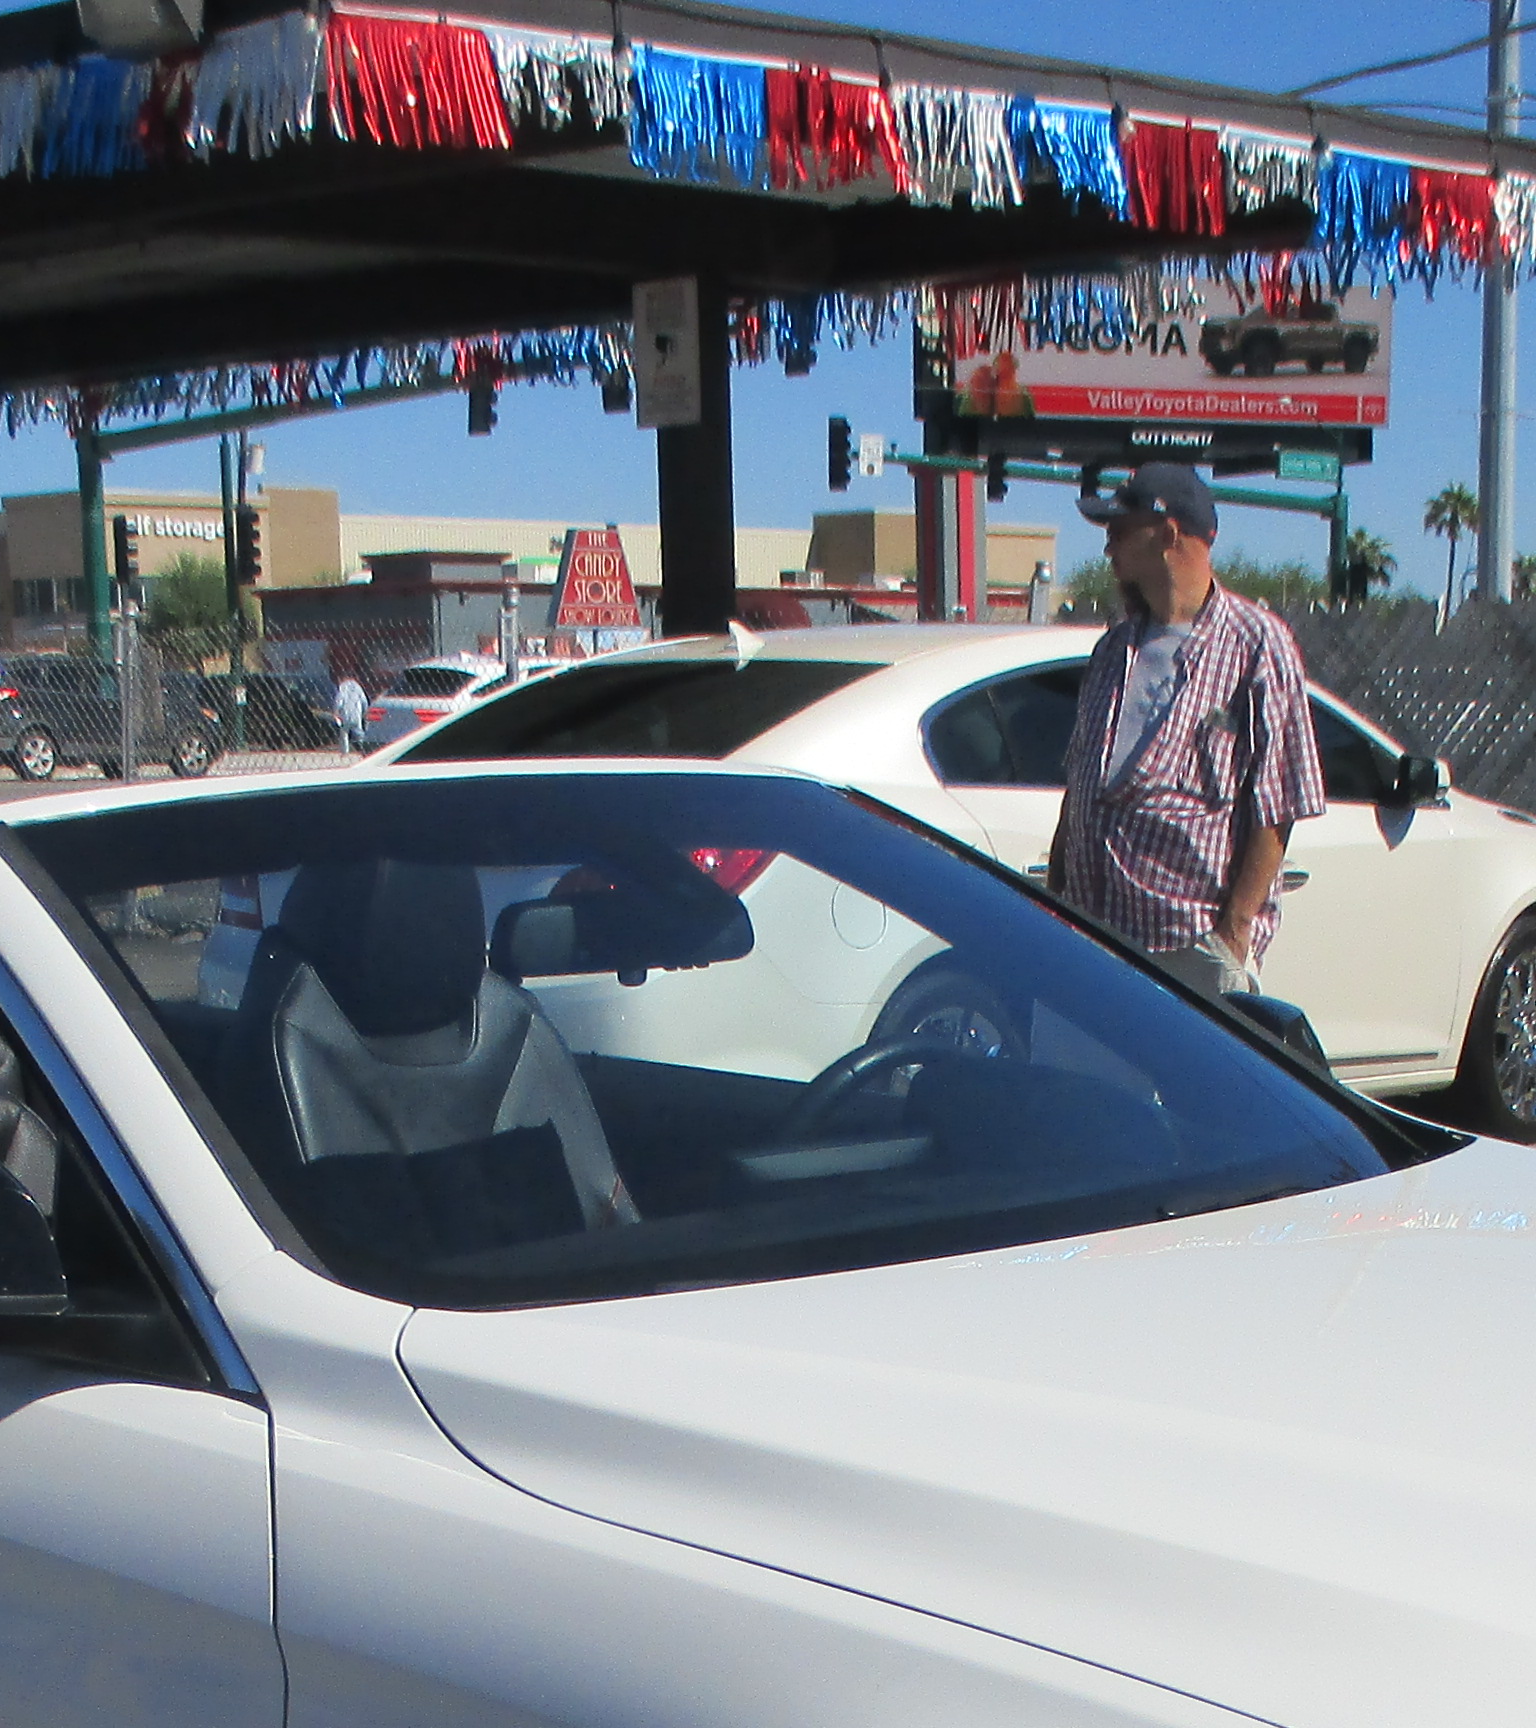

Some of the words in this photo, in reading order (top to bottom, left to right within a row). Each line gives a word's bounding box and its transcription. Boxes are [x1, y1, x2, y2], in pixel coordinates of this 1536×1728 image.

[1086, 389, 1319, 417] ValleyToyotaDealers.com
[588, 531, 607, 547] THE
[575, 552, 622, 578] CANDY
[574, 579, 622, 604] STORE
